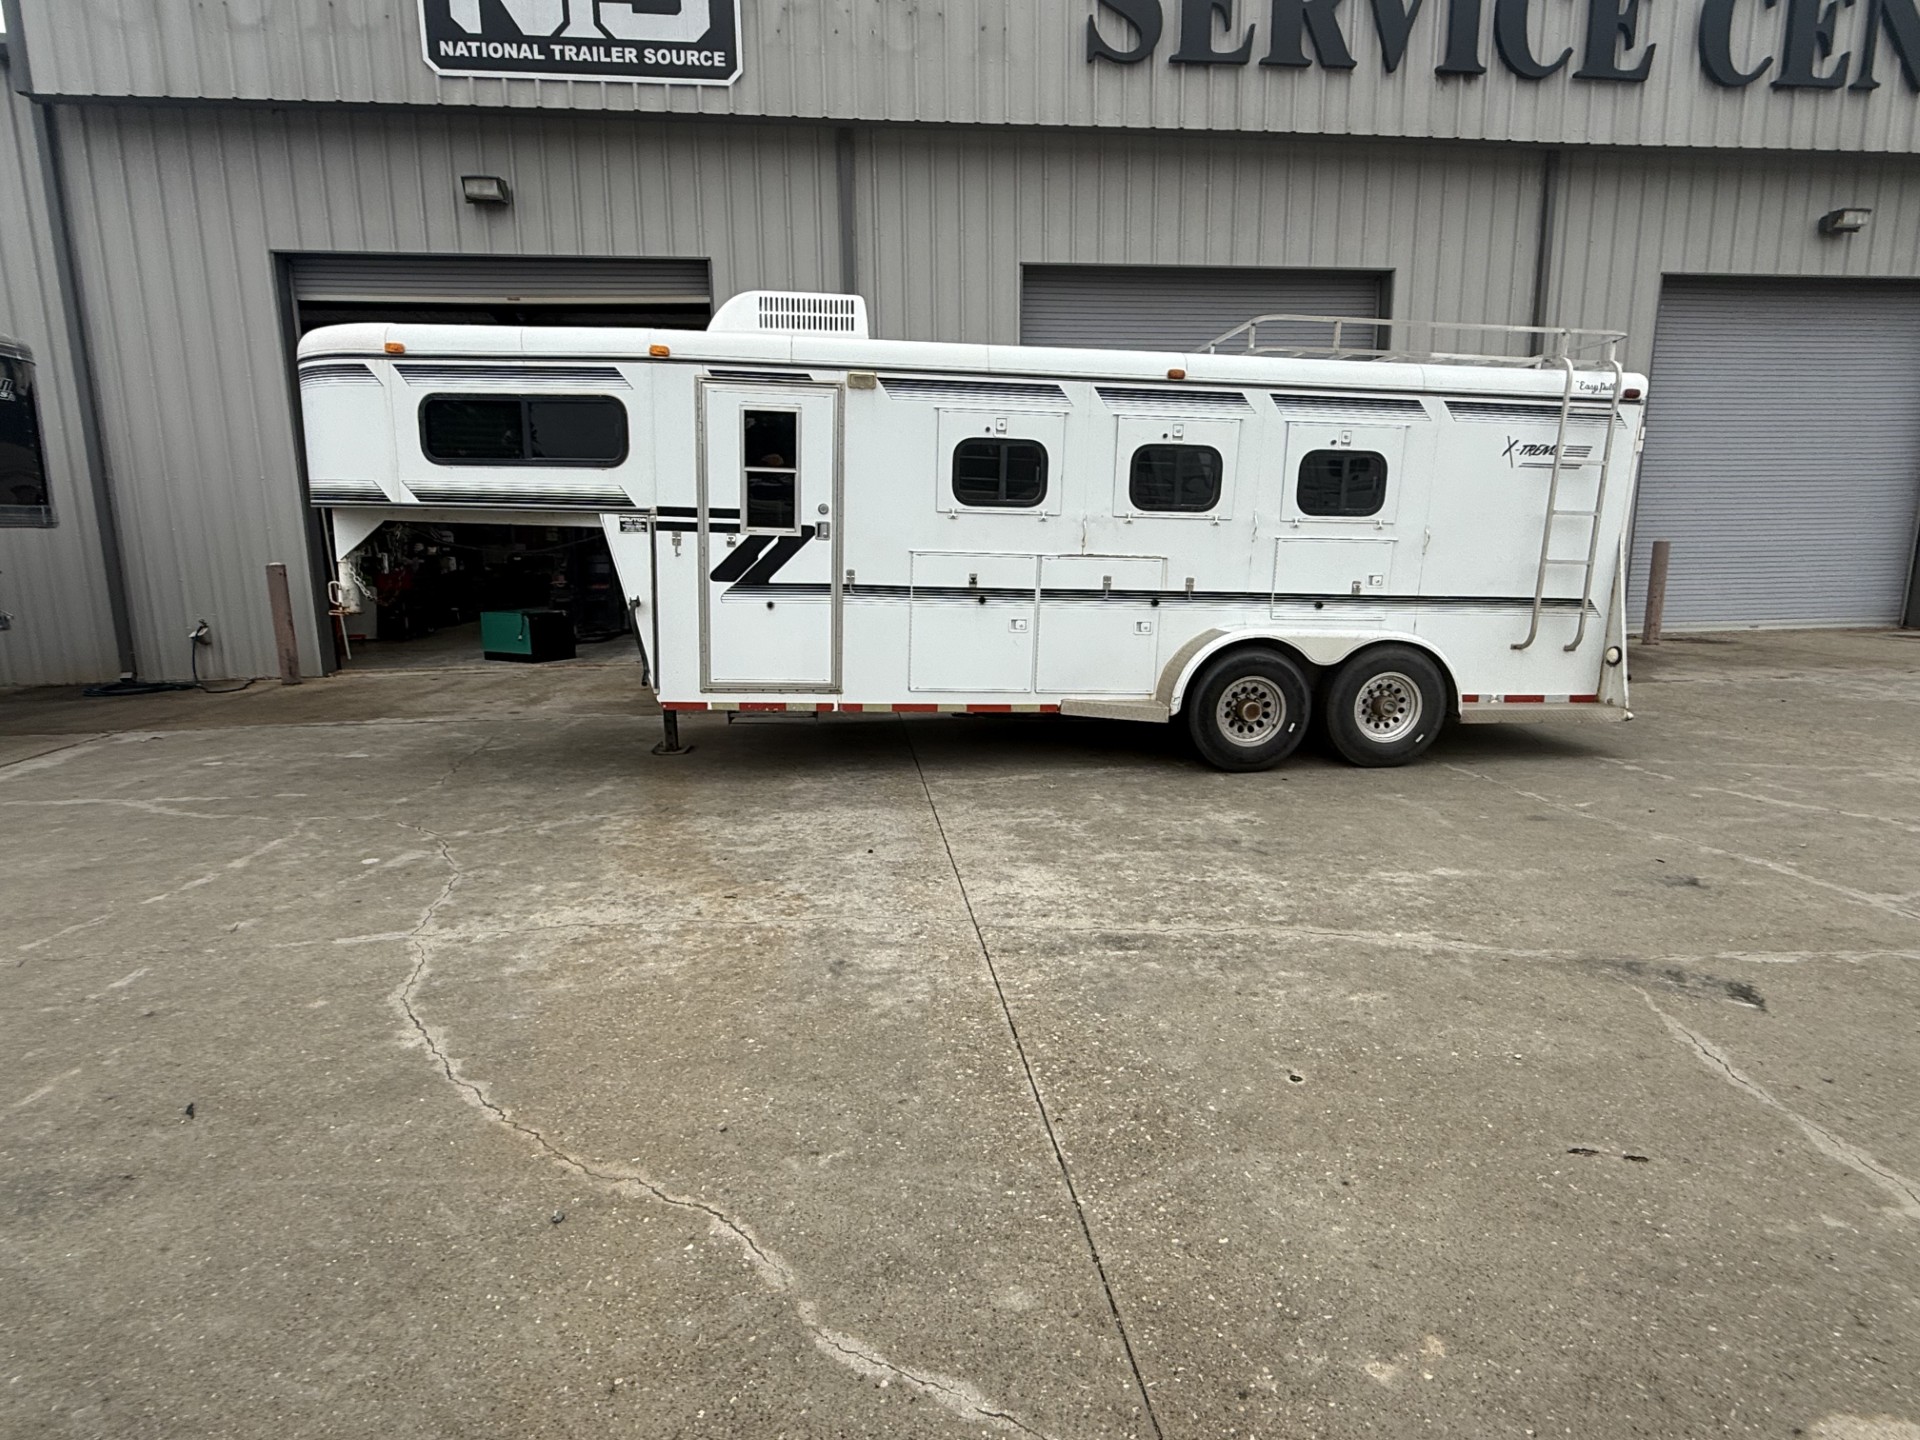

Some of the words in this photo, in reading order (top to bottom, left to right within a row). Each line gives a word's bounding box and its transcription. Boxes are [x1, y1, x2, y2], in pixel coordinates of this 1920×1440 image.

[439, 40, 546, 60] NATIONAL
[550, 44, 639, 64] TRAILER
[643, 48, 727, 67] SOURCE
